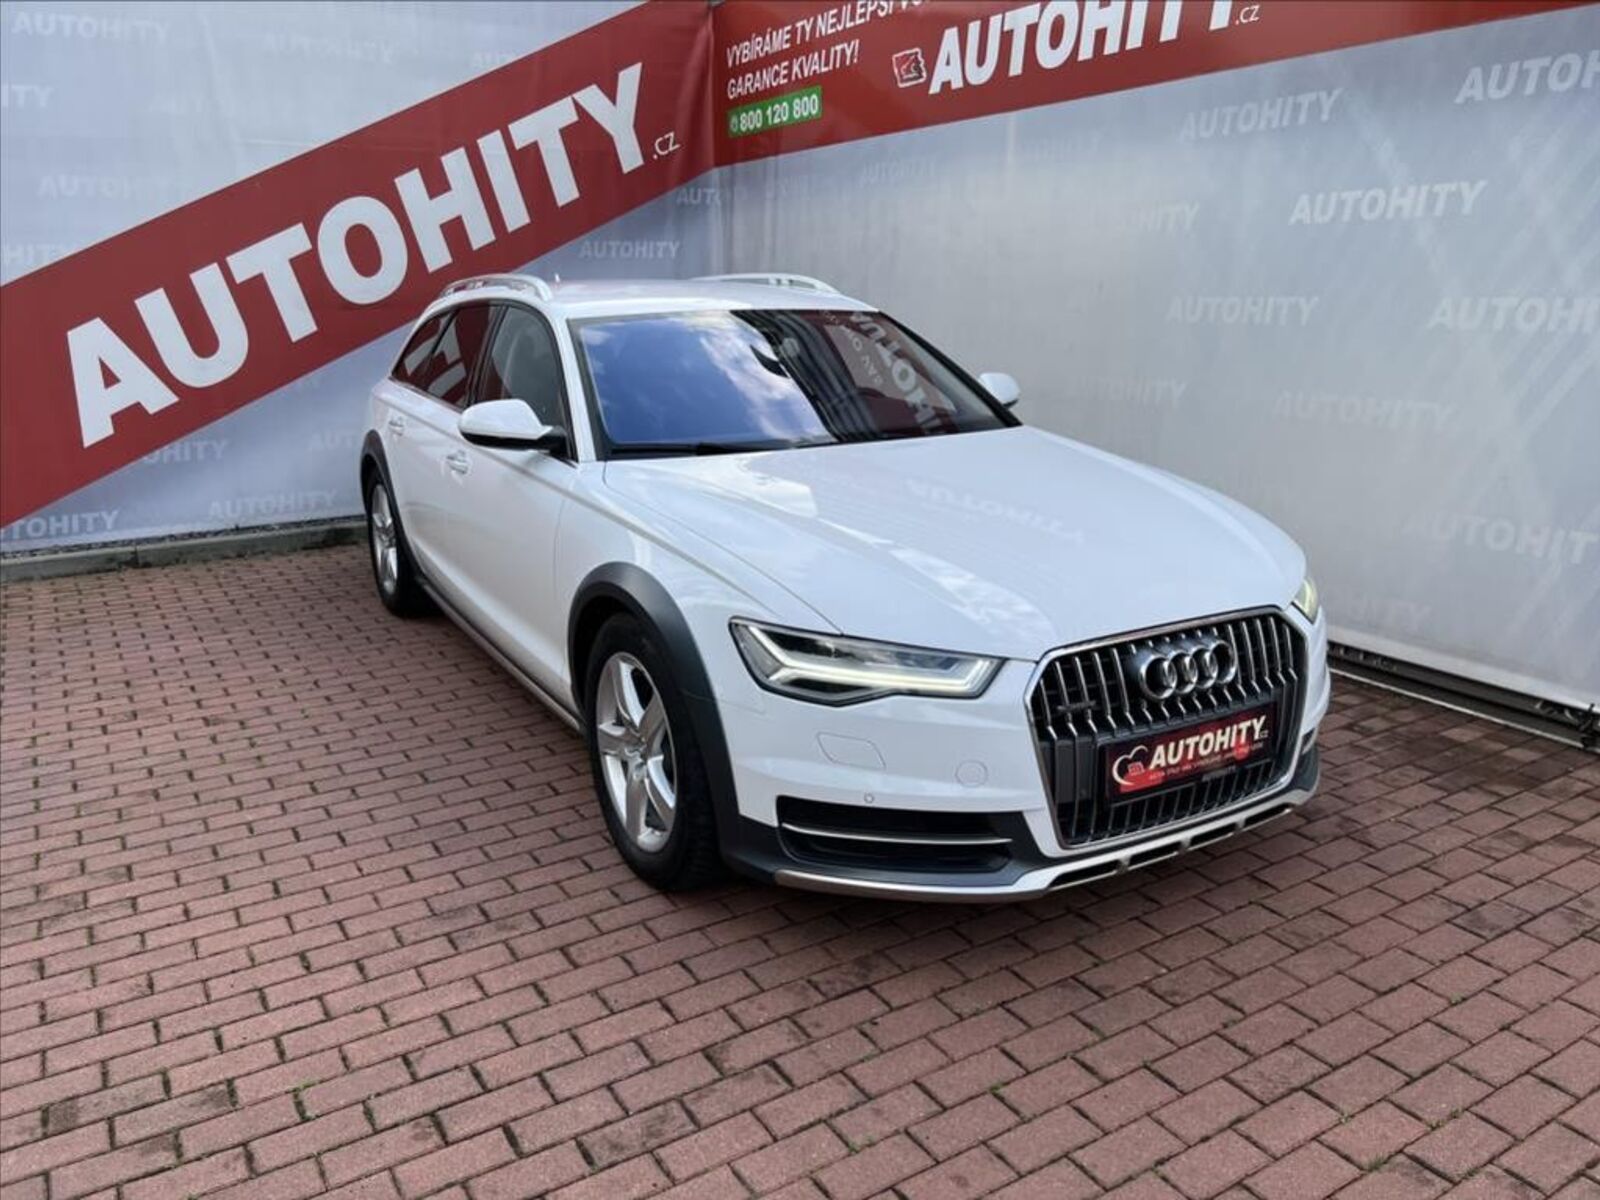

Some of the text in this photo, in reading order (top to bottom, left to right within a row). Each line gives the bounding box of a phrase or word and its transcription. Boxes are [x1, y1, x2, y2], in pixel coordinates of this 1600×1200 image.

[10, 12, 169, 43] AUTOHITY
[795, 17, 815, 45] TY
[727, 39, 860, 100] GARANCE KVALITY!
[740, 94, 819, 133] 800 120 800
[1178, 88, 1343, 143] AUTOHITY
[1288, 180, 1488, 226] AUTOHITY
[67, 62, 643, 449] AUTOHITY
[580, 240, 680, 260] AUTOHITY
[1165, 296, 1319, 327] AUTOHITY
[207, 489, 337, 521] AUTOHITY
[0, 510, 119, 540] TOHITY
[1149, 715, 1267, 770] AUTOHITY
